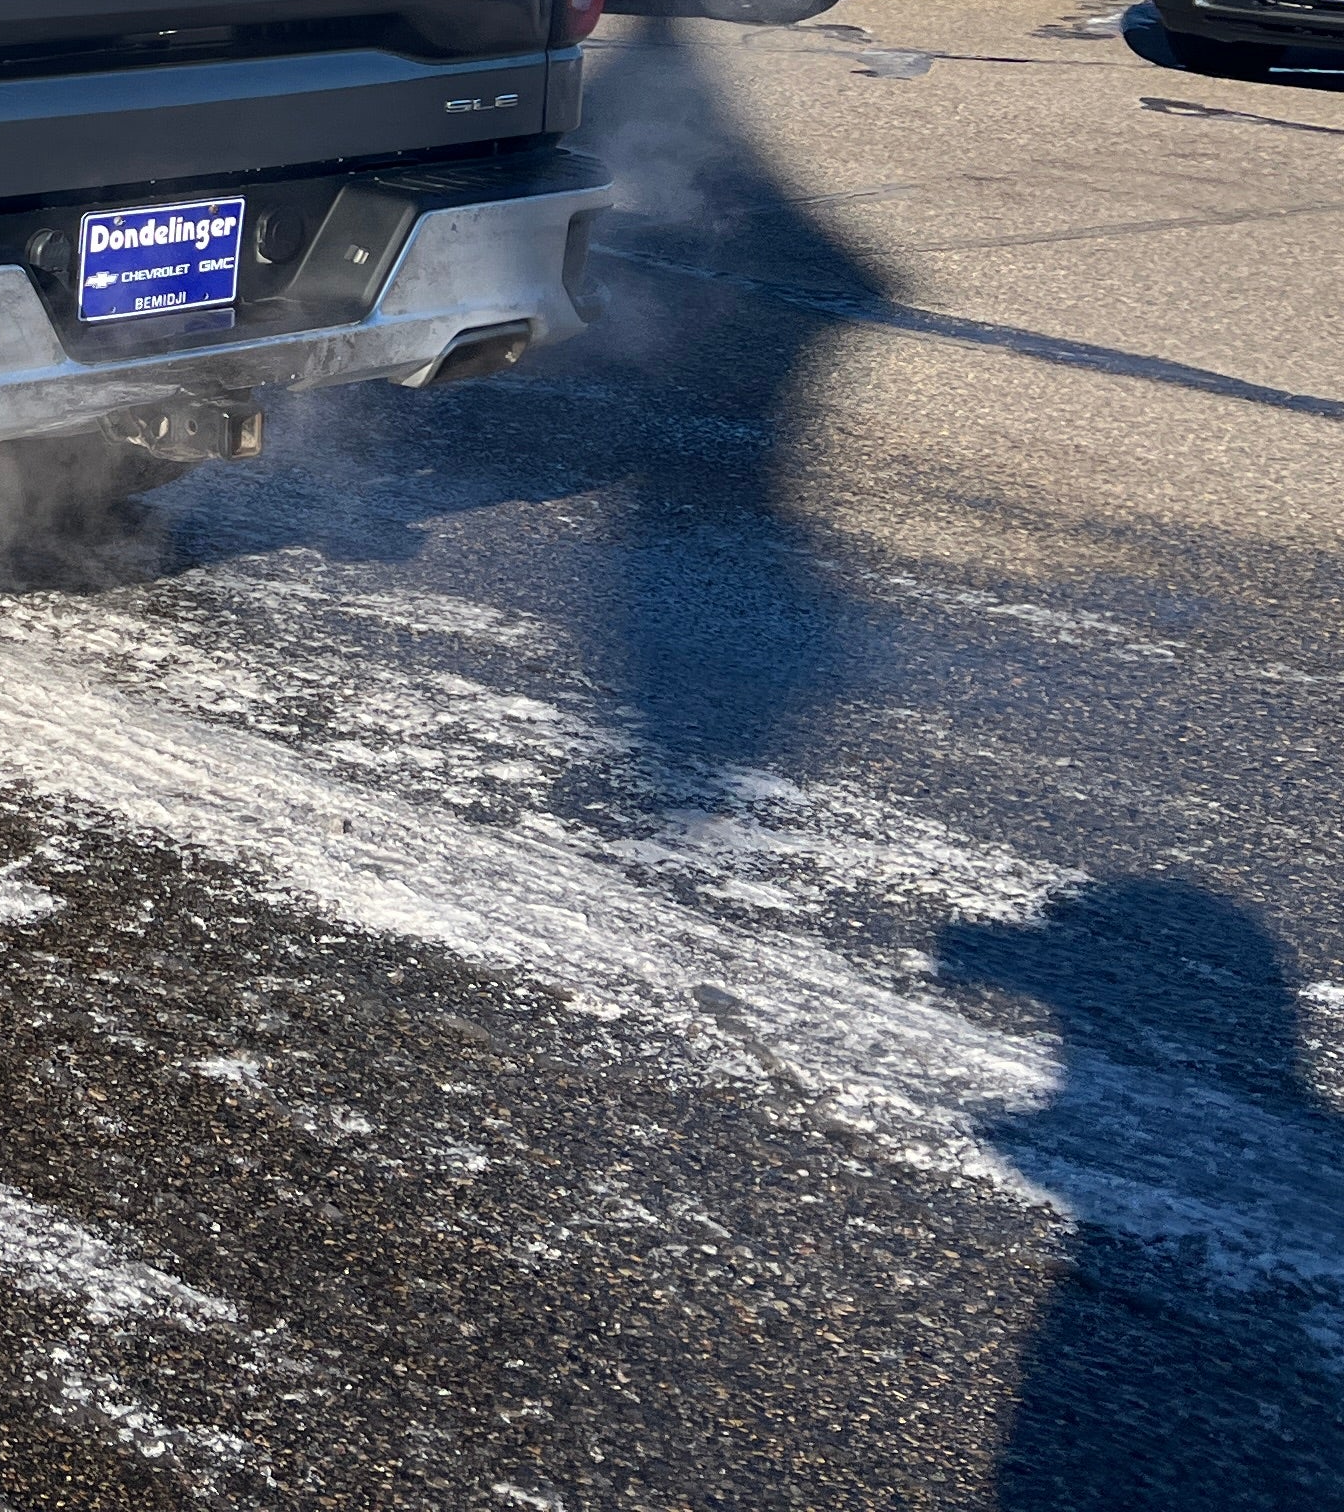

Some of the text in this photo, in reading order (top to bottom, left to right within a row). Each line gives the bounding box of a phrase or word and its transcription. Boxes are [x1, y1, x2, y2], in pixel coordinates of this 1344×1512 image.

[445, 94, 519, 113] SLE
[90, 216, 237, 253] Dondelinger
[121, 257, 235, 283] CHEVROLET GMC
[135, 291, 187, 311] BEMIDJI
